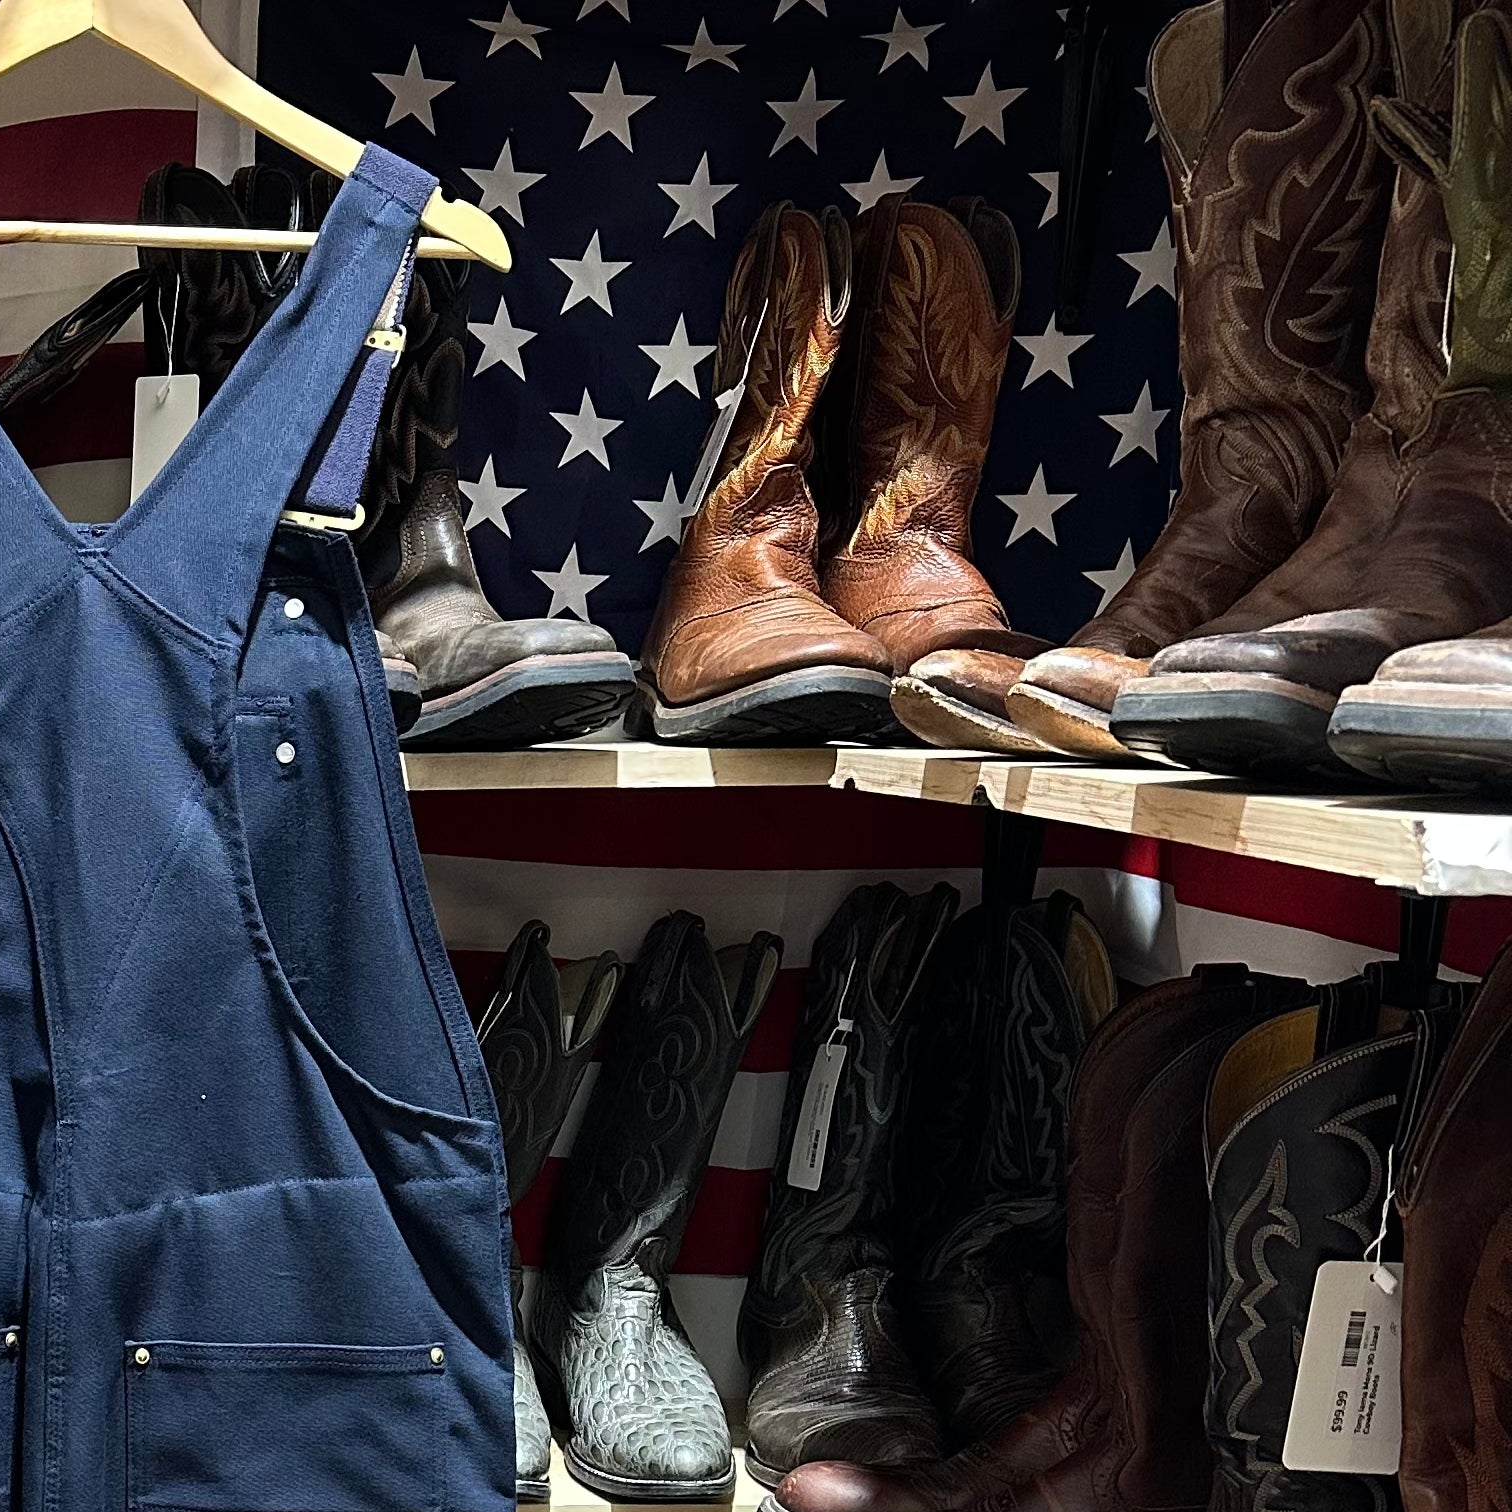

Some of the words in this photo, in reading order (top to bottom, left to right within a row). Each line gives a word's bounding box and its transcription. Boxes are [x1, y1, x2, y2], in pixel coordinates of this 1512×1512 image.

[1354, 1413, 1365, 1434] Tony
[1369, 1325, 1380, 1351] Lizard
[1369, 1374, 1380, 1399] Boots
[1331, 1390, 1348, 1432] $99.99
[1363, 1400, 1376, 1434] Cowboy
